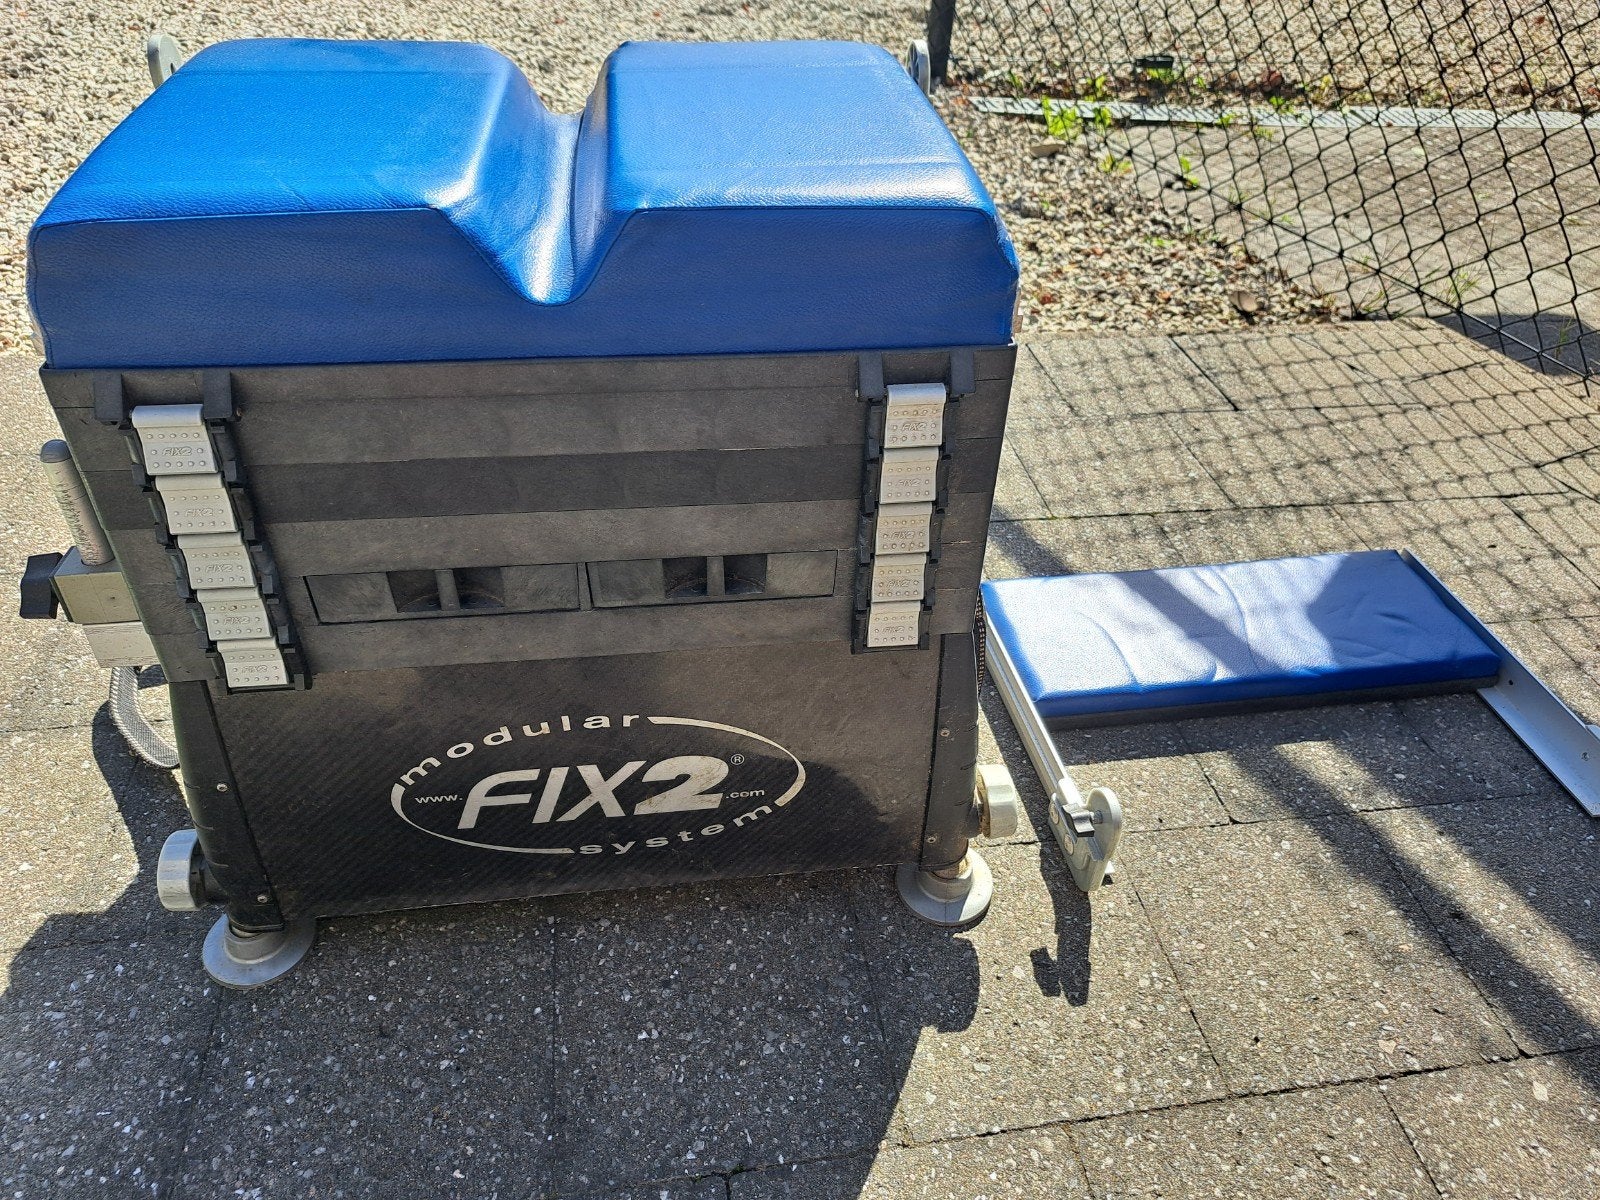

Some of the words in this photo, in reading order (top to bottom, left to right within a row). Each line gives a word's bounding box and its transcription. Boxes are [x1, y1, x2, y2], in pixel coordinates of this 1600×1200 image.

[161, 446, 194, 457] FIX2
[184, 508, 214, 517] FIX2
[204, 564, 234, 573] FIX2
[400, 713, 640, 786] modular
[414, 793, 463, 805] www.
[457, 755, 729, 830] FIX2
[579, 803, 772, 856] system
